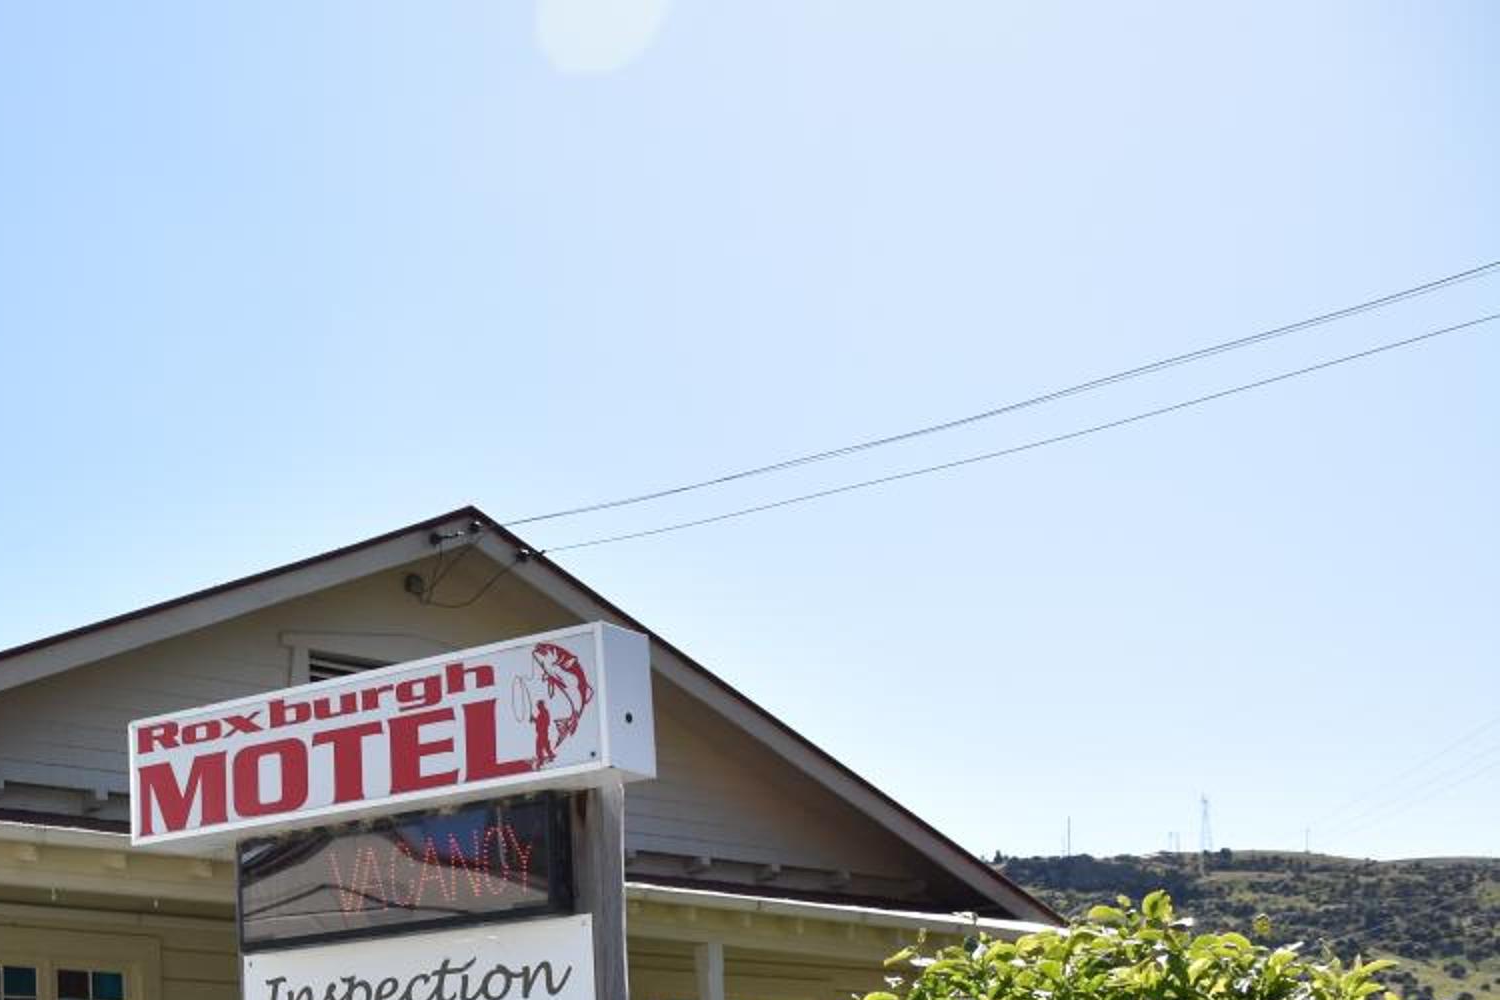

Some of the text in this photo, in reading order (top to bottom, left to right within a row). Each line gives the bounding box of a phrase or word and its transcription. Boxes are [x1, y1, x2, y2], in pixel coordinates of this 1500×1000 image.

[137, 663, 495, 754] Roxburgh
[138, 698, 531, 836] MOTEL
[328, 823, 532, 914] VACANCY
